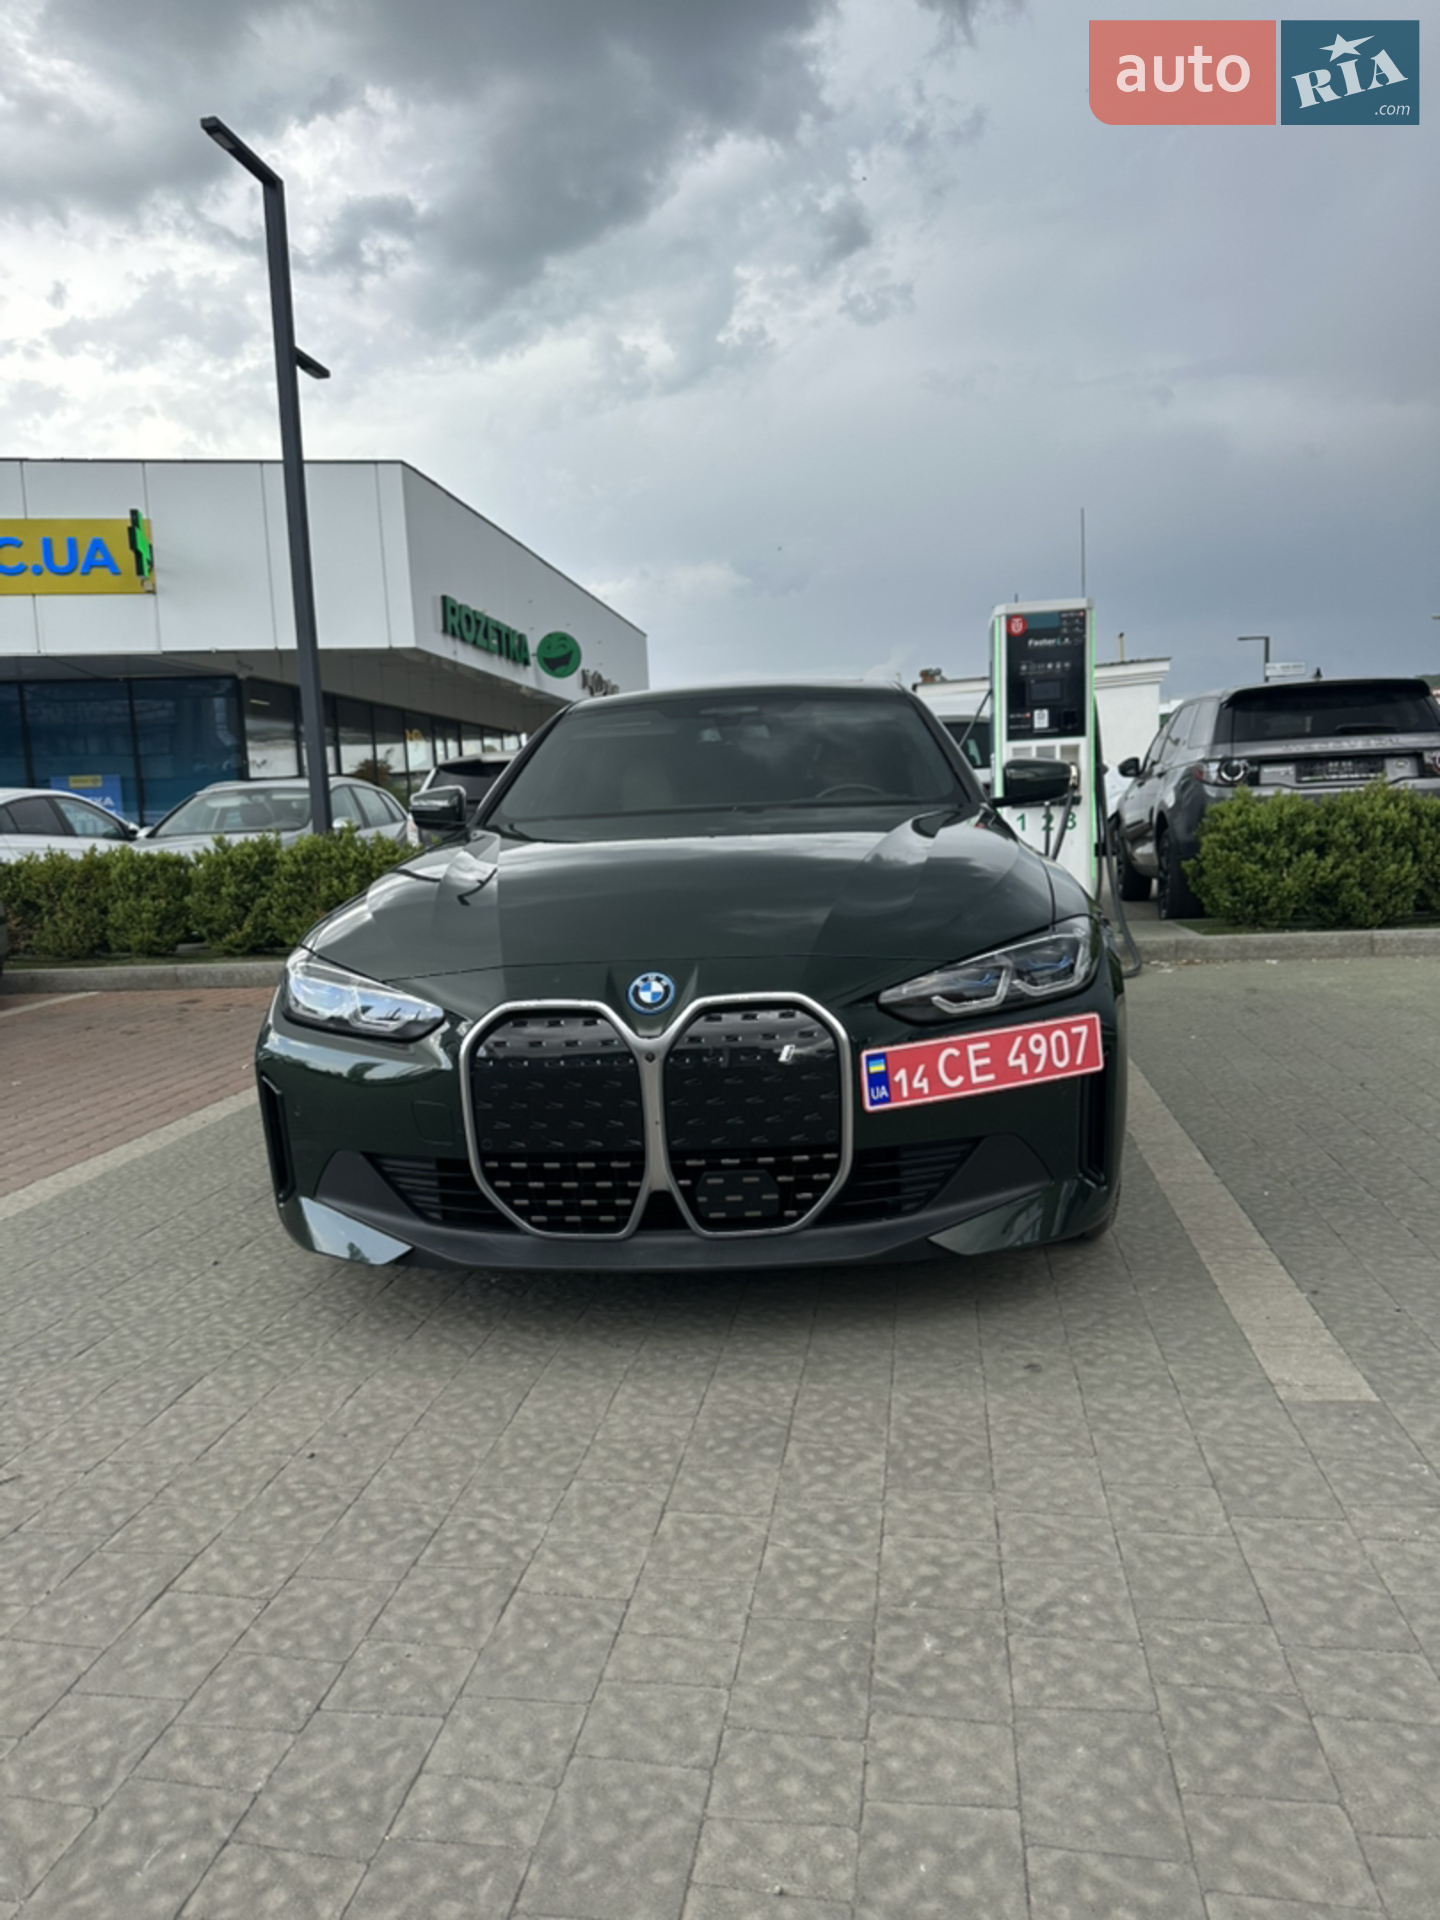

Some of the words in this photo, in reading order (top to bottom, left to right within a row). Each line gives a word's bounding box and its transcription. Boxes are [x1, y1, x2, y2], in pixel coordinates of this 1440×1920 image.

[441, 594, 532, 667] ROZETKA
[1016, 813, 1026, 831] 1
[893, 1064, 930, 1098] 14
[938, 1041, 996, 1088] CE
[1006, 1024, 1089, 1075] 4907
[870, 1085, 890, 1100] UA
